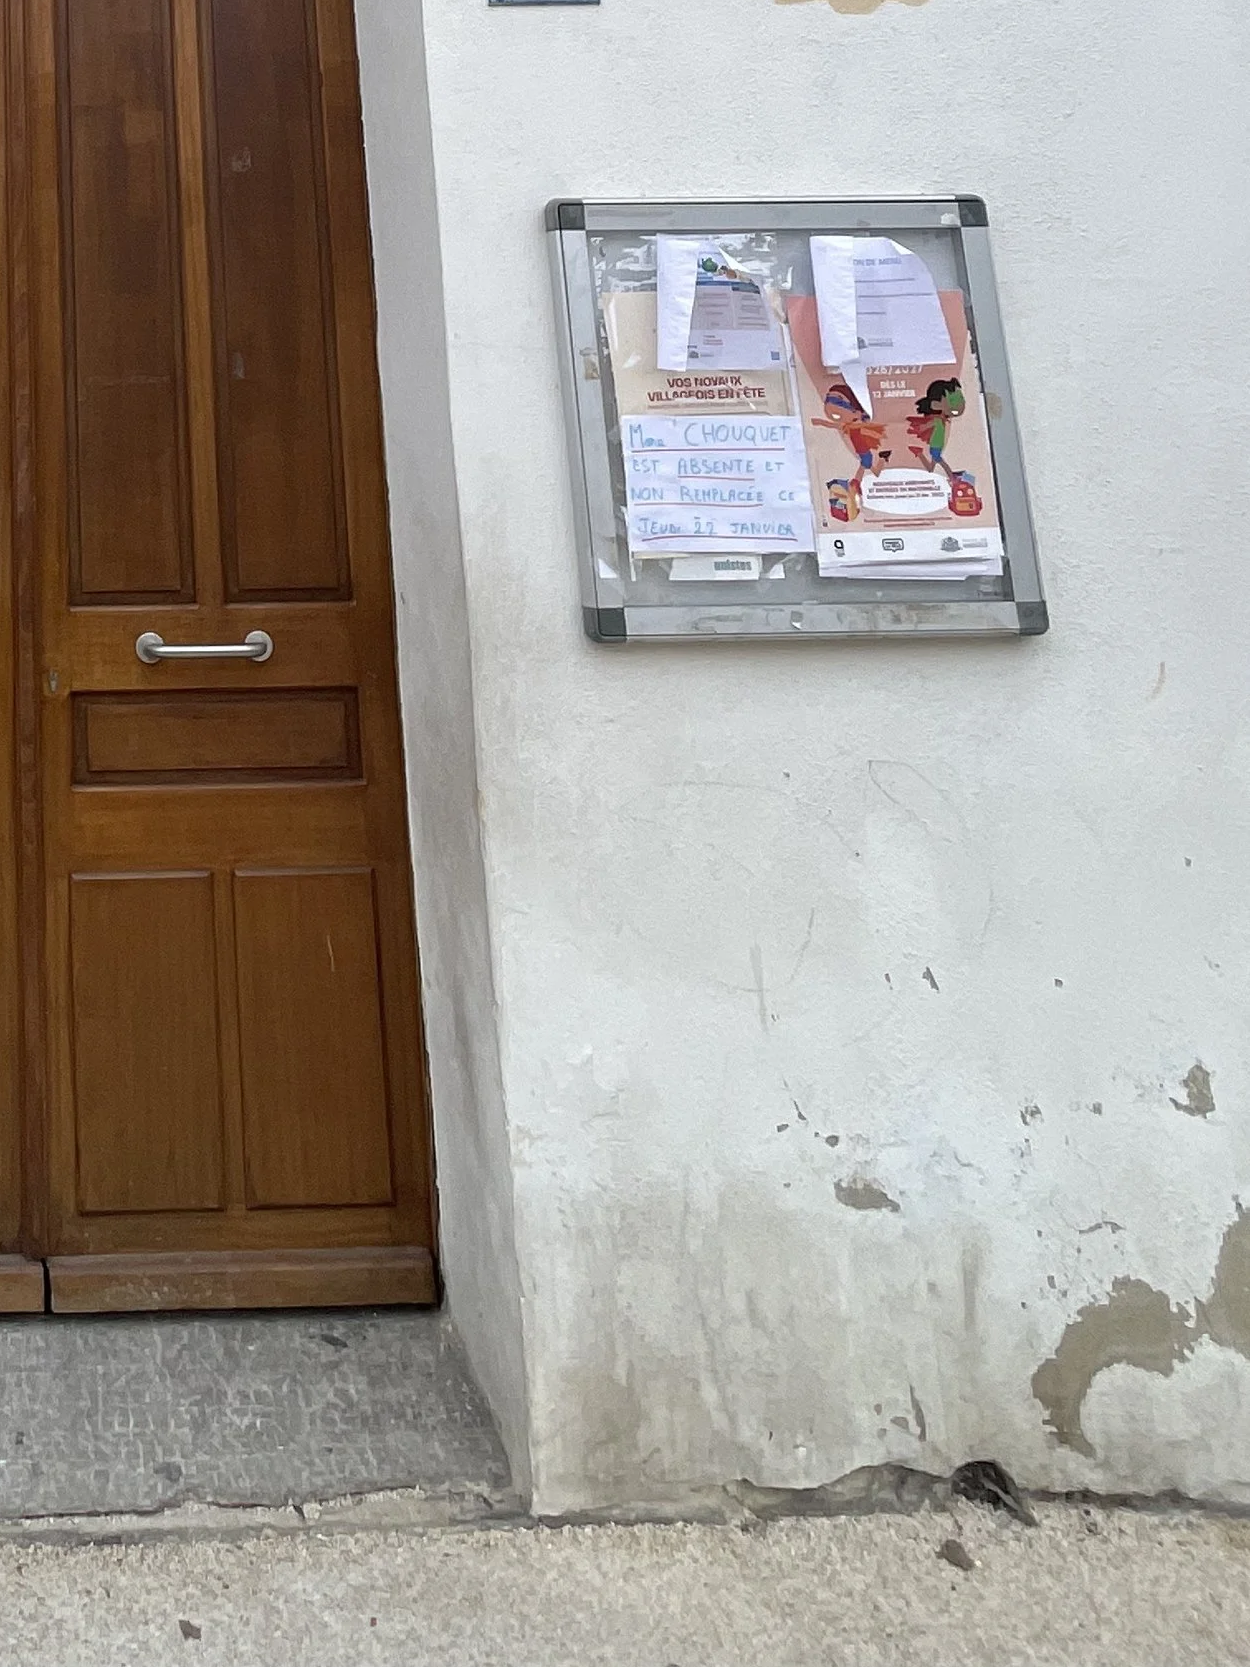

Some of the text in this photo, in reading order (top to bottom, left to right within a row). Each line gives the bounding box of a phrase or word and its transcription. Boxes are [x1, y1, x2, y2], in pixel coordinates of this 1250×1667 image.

[667, 377, 691, 388] VOS
[684, 422, 791, 446] CHOUQUET
[632, 457, 785, 475] EST ABSENTE ET
[631, 487, 664, 502] NON
